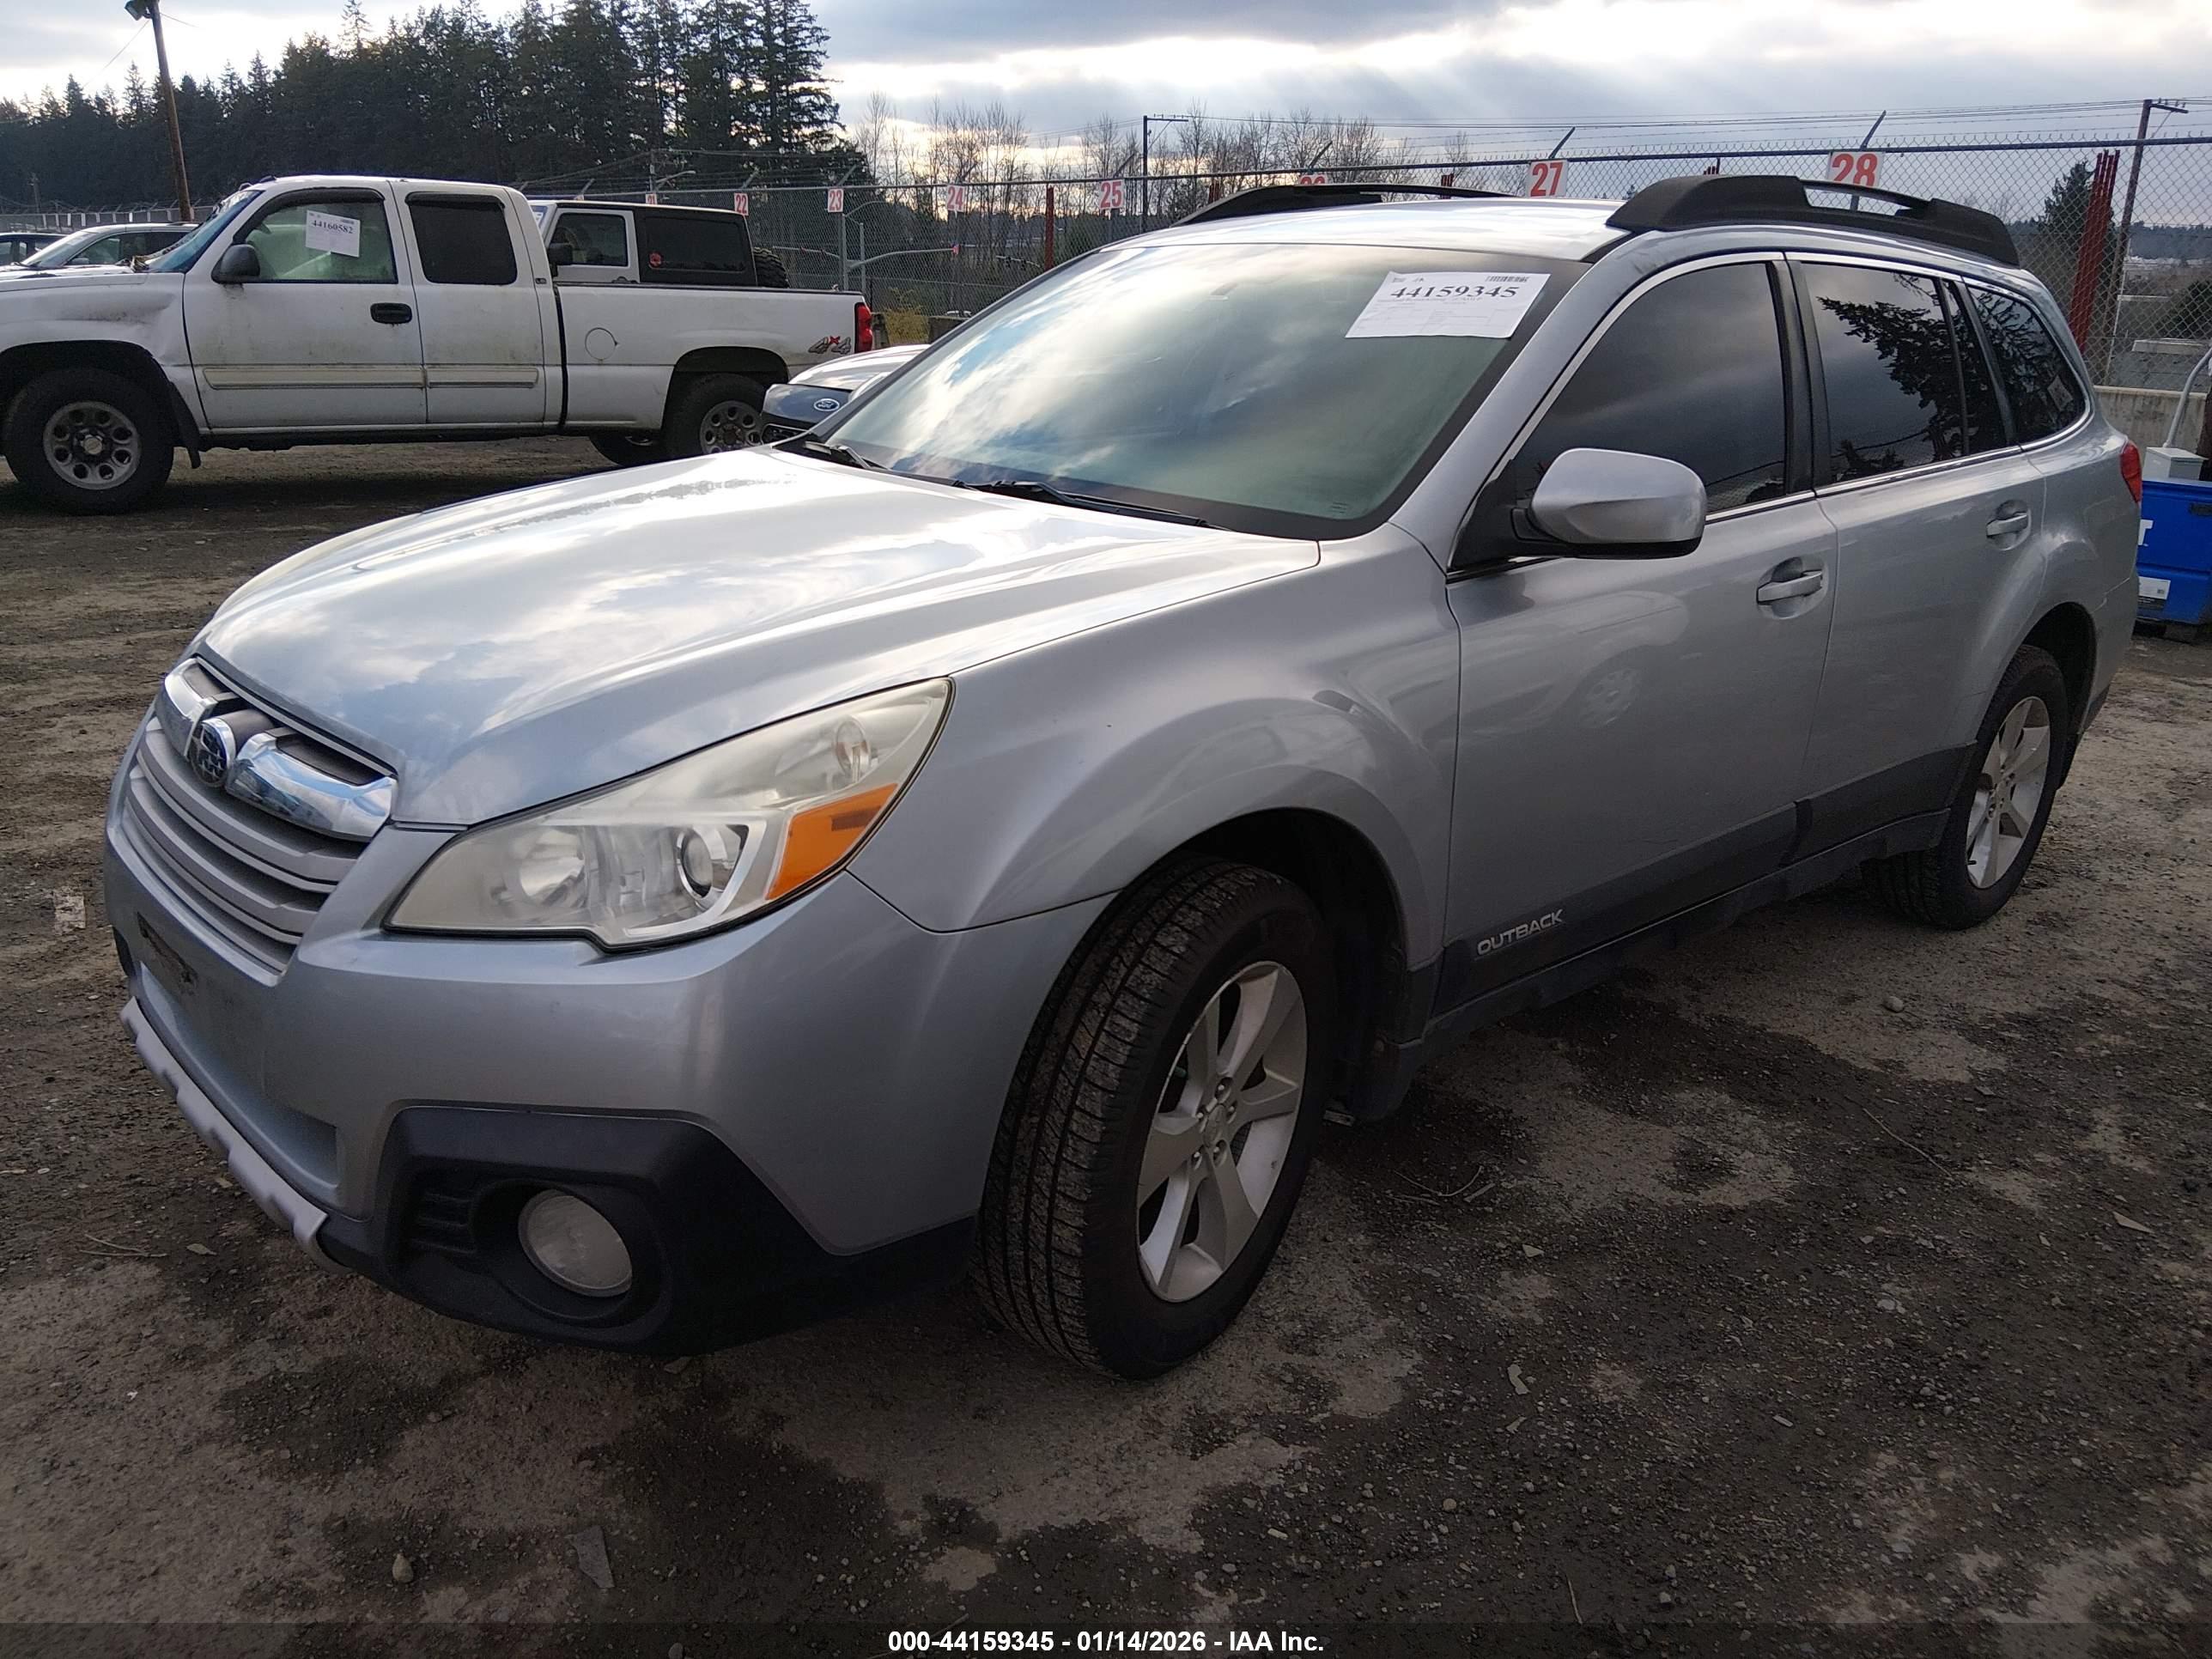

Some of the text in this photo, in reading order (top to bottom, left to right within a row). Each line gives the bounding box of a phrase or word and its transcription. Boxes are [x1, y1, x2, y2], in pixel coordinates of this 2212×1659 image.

[1530, 162, 1563, 197] 27
[1832, 153, 1878, 186] 28
[734, 194, 747, 214] 22
[830, 190, 842, 211] 23
[947, 186, 964, 210] 24
[1100, 180, 1122, 209] 25
[312, 220, 354, 234] 44160582
[1390, 285, 1520, 298] 44159345
[1477, 908, 1563, 955] OUTBACK
